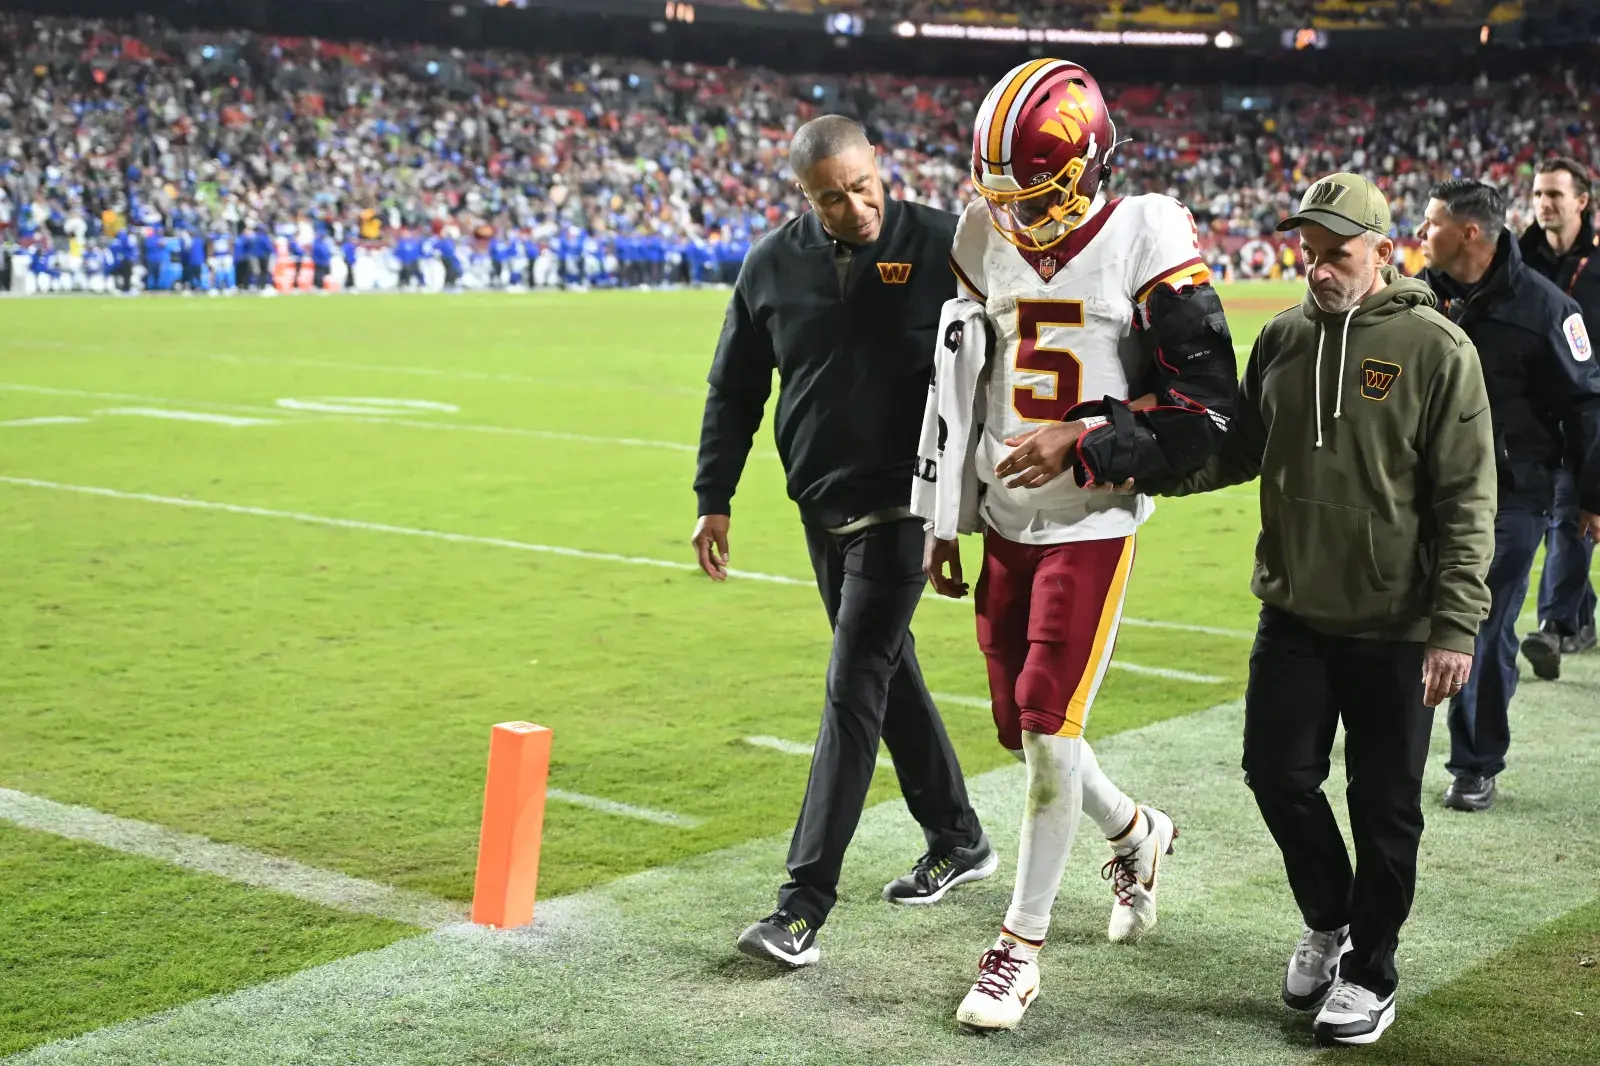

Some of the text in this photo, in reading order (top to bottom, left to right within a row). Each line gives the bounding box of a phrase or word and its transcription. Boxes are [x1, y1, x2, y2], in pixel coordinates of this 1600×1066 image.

[876, 262, 912, 284] W
[1012, 299, 1085, 424] 5
[1365, 369, 1394, 391] W
